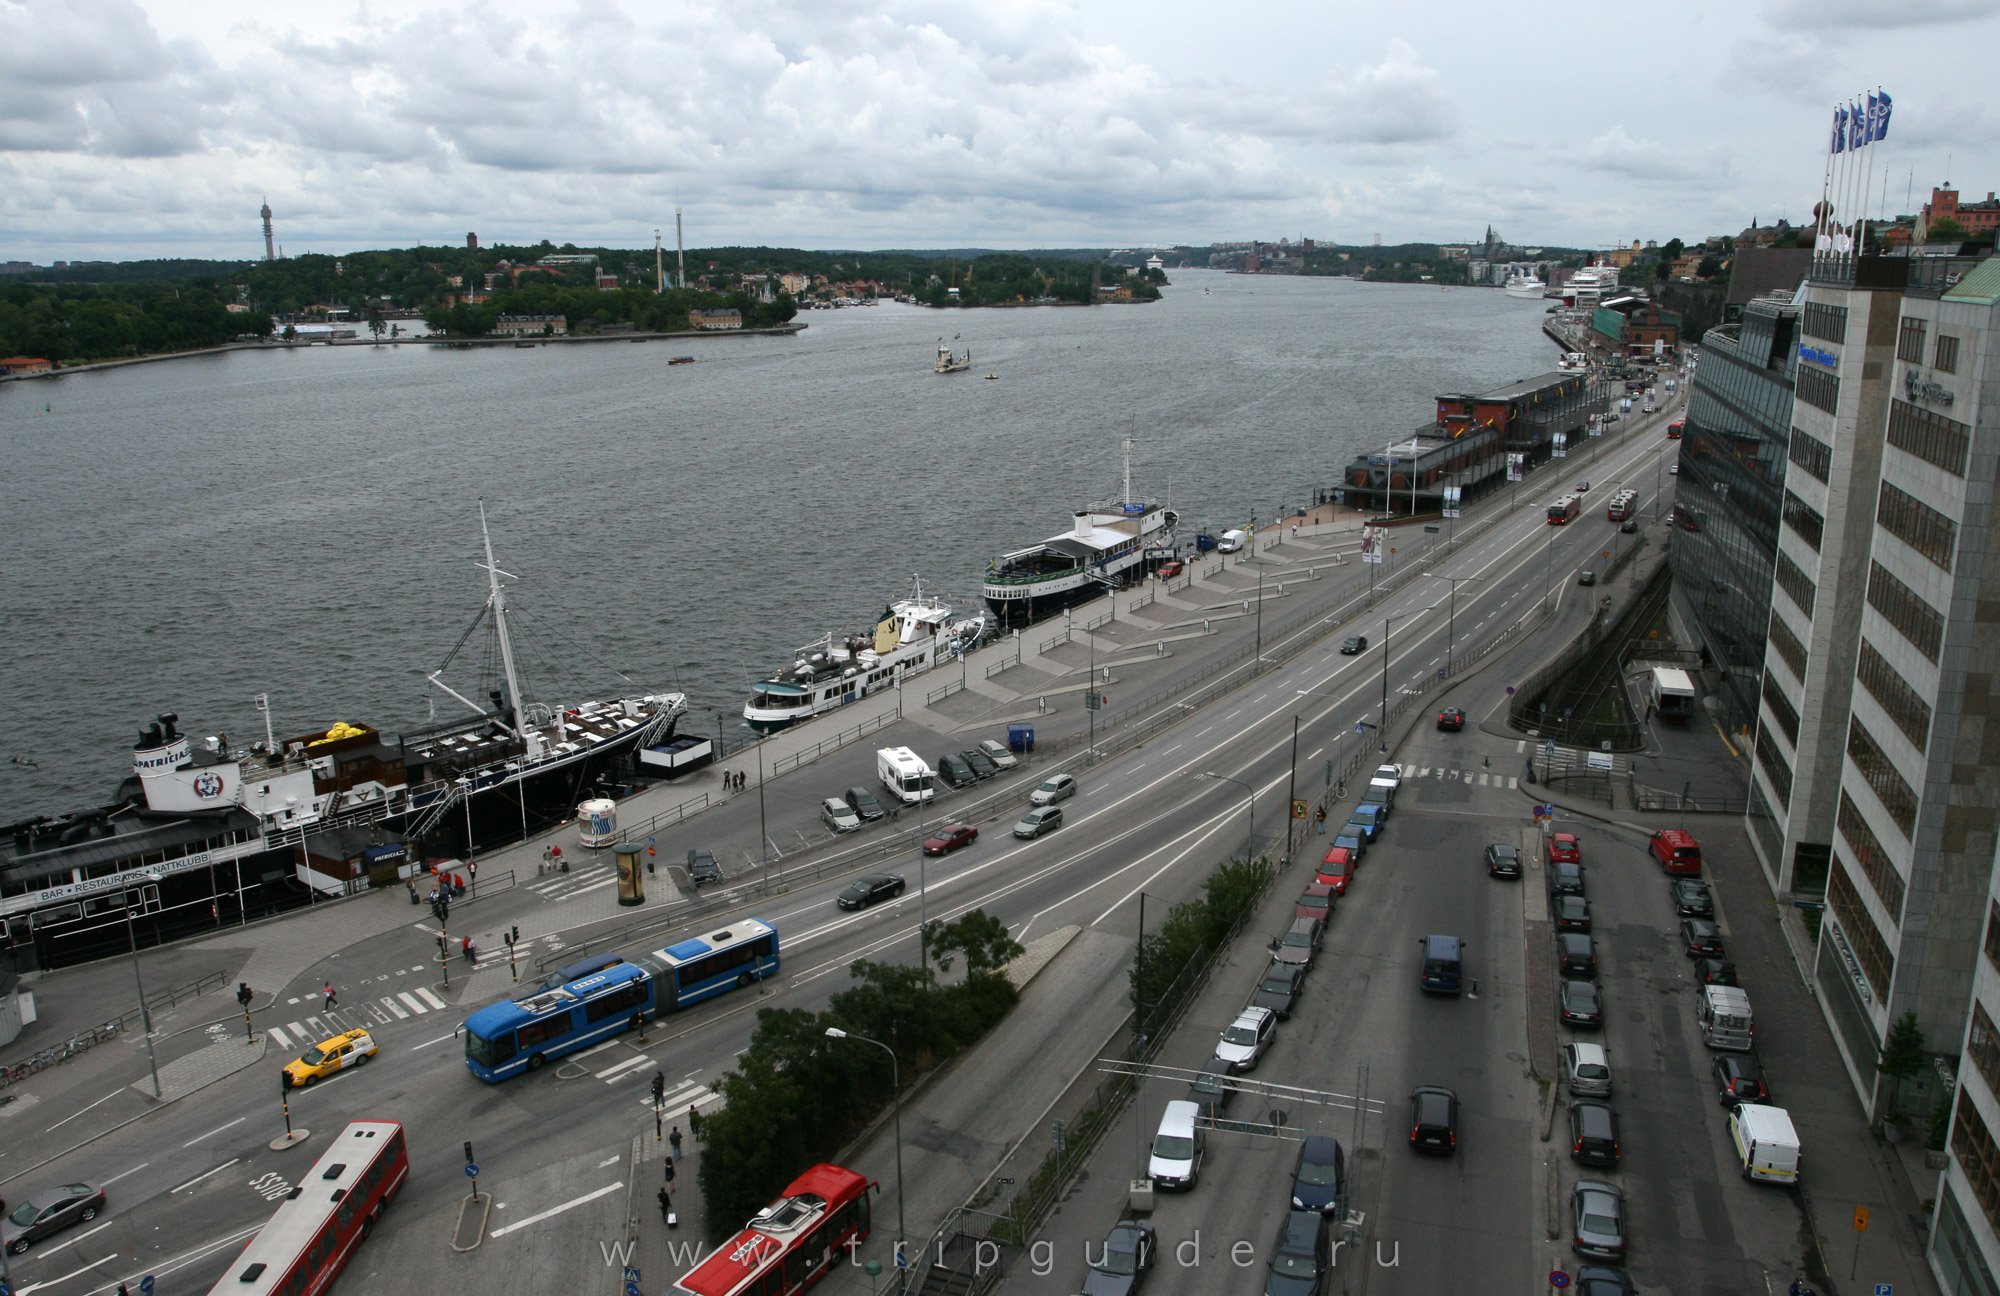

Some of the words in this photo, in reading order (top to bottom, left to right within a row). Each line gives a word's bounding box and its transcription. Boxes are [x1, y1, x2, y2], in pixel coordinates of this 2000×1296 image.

[138, 752, 185, 768] PATRICIA
[41, 888, 64, 901] BAR
[75, 870, 142, 893] RESTAURANG
[153, 853, 209, 874] NATTKLUBB
[248, 1171, 294, 1202] BUSS
